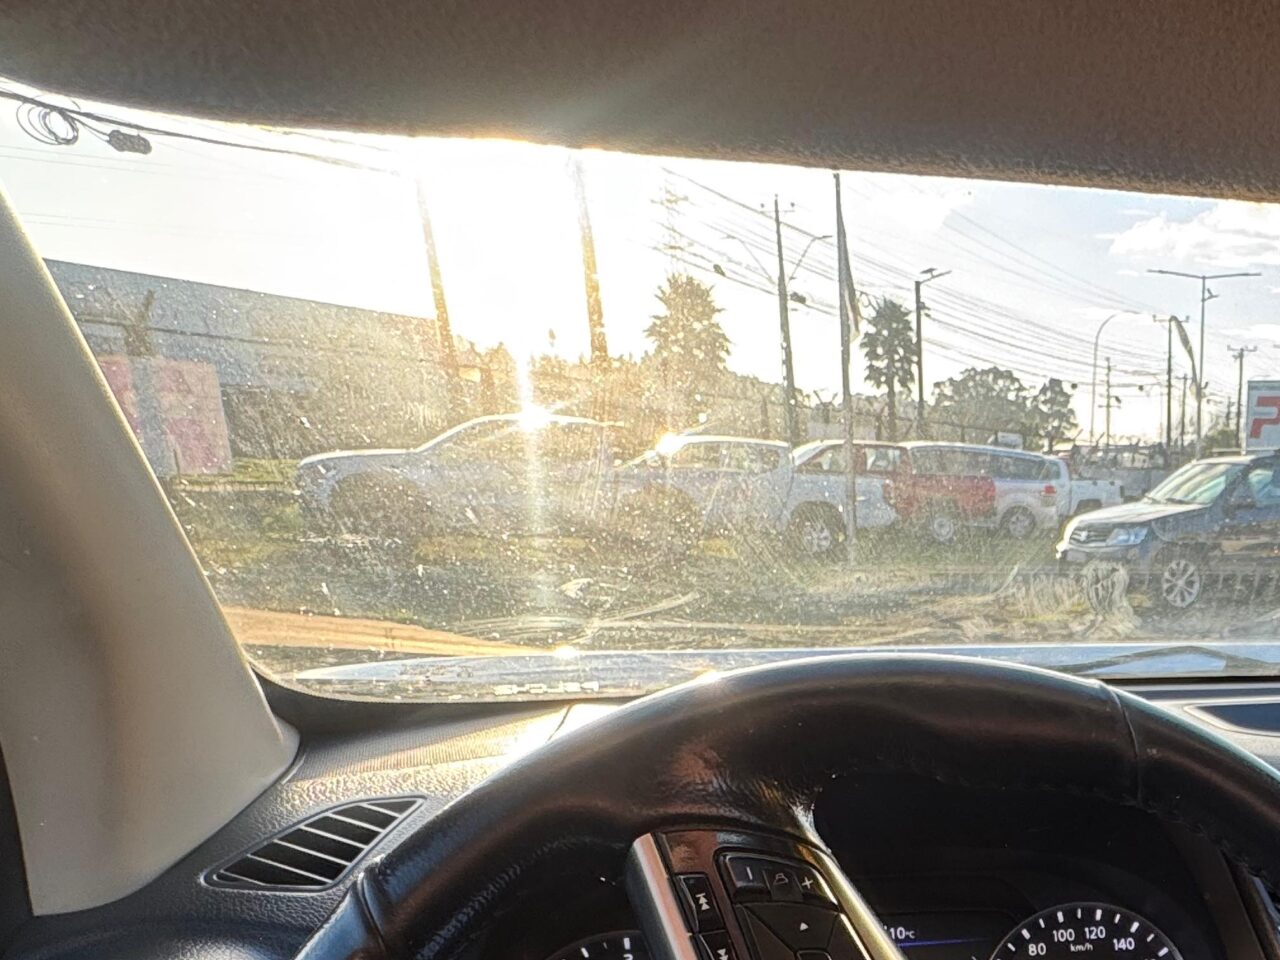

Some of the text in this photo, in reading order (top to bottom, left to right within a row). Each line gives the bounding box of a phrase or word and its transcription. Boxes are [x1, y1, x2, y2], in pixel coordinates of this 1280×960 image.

[1053, 926, 1106, 942] 100 120
[1028, 937, 1136, 957] 80 140
[1070, 942, 1094, 953] km/h
